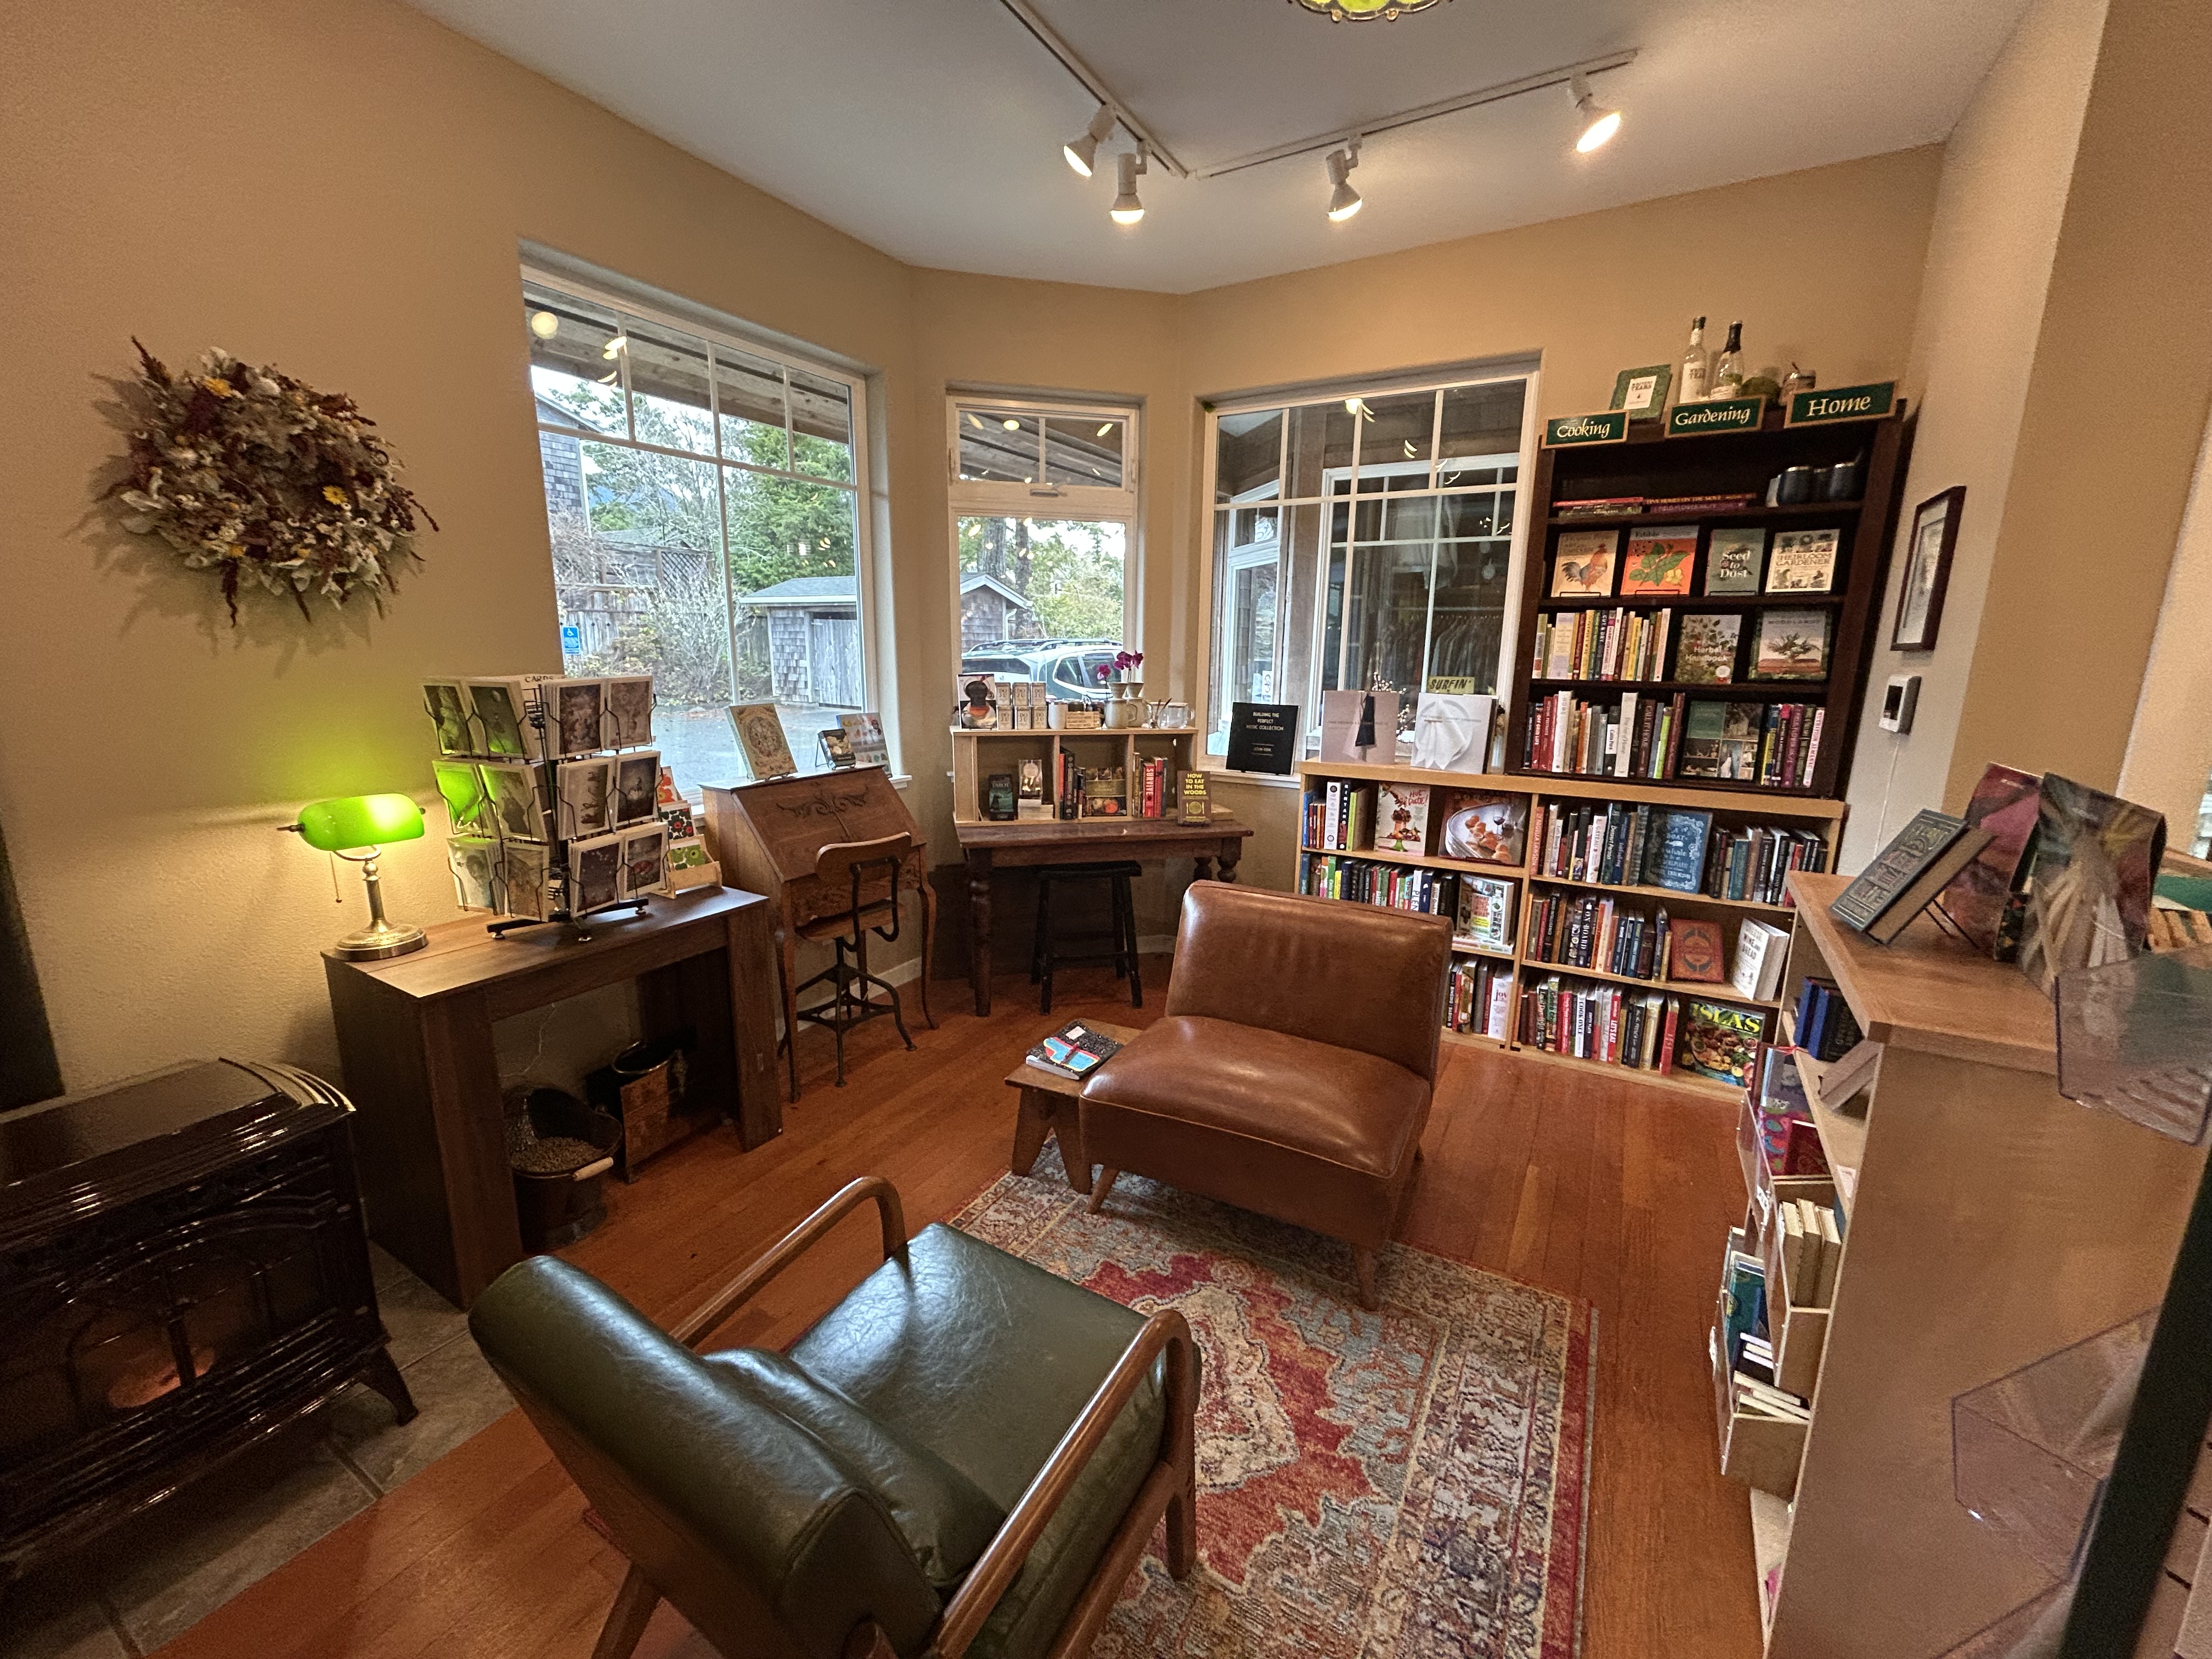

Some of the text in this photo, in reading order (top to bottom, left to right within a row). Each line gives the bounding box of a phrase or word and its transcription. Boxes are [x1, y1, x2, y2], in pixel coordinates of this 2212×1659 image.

[1675, 406, 1751, 426] Gardening
[1807, 396, 1871, 416] Home
[1556, 418, 1611, 438] Cooking
[1722, 550, 1752, 561] Seed
[1720, 568, 1748, 578] Dust
[1429, 679, 1471, 690] SURFIN'
[1146, 768, 1154, 795] SURVIVE
[1412, 890, 1421, 911] PLEN
[1581, 910, 1592, 950] ON BOARD
[1693, 1003, 1760, 1033] ISLAS
